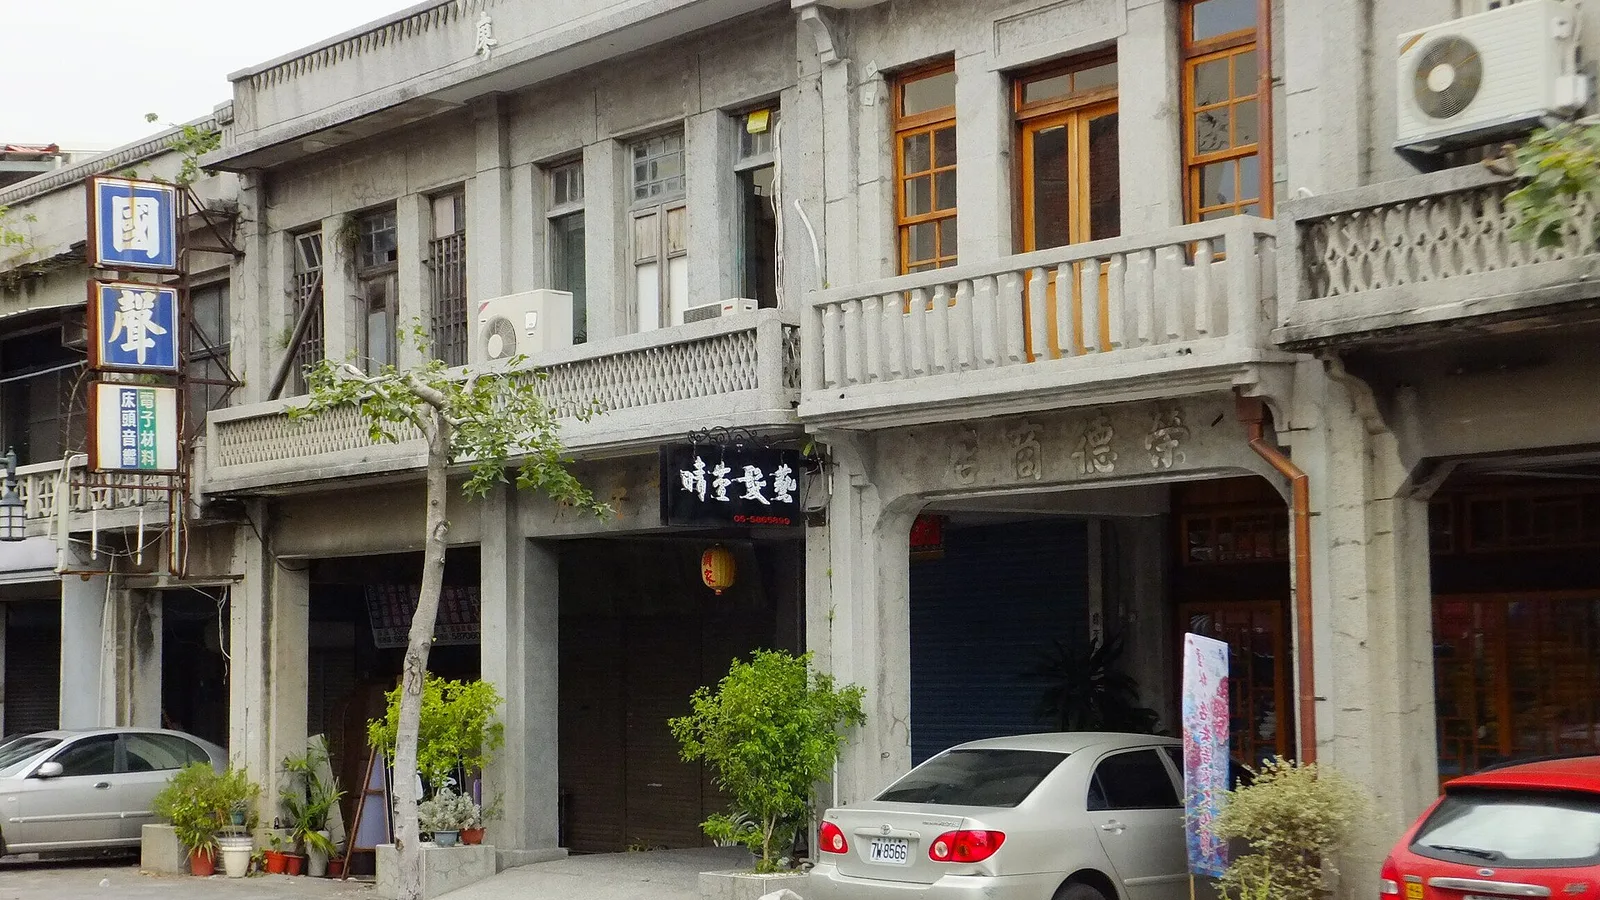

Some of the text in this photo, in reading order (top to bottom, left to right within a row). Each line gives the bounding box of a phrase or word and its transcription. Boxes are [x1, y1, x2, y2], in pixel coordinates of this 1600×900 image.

[108, 195, 167, 365] 國聲
[121, 391, 138, 467] 床頭音響
[140, 391, 156, 467] 電子材料
